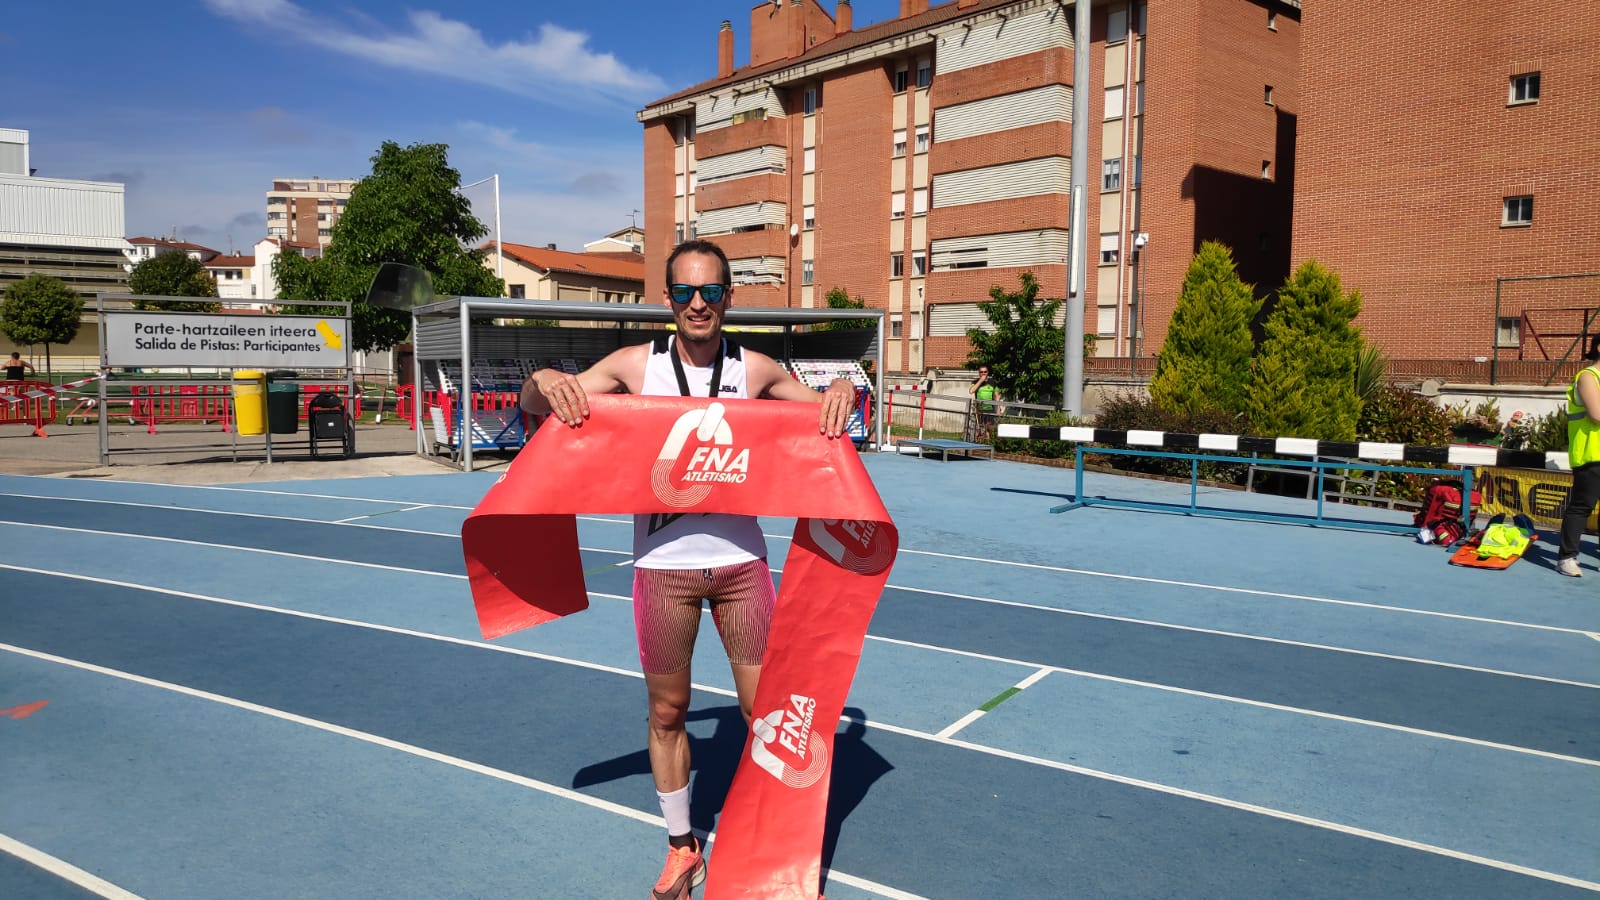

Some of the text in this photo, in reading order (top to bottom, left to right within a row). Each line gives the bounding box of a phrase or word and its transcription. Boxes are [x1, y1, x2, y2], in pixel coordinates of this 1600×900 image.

[134, 322, 317, 338] Parte-hartzaileen irteera
[135, 337, 321, 355] Salida de Pistas: Participantes
[686, 446, 750, 473] FNA
[681, 471, 747, 484] ATLETISMO
[778, 693, 809, 754] FNA
[796, 697, 816, 760] ATLETISMO
